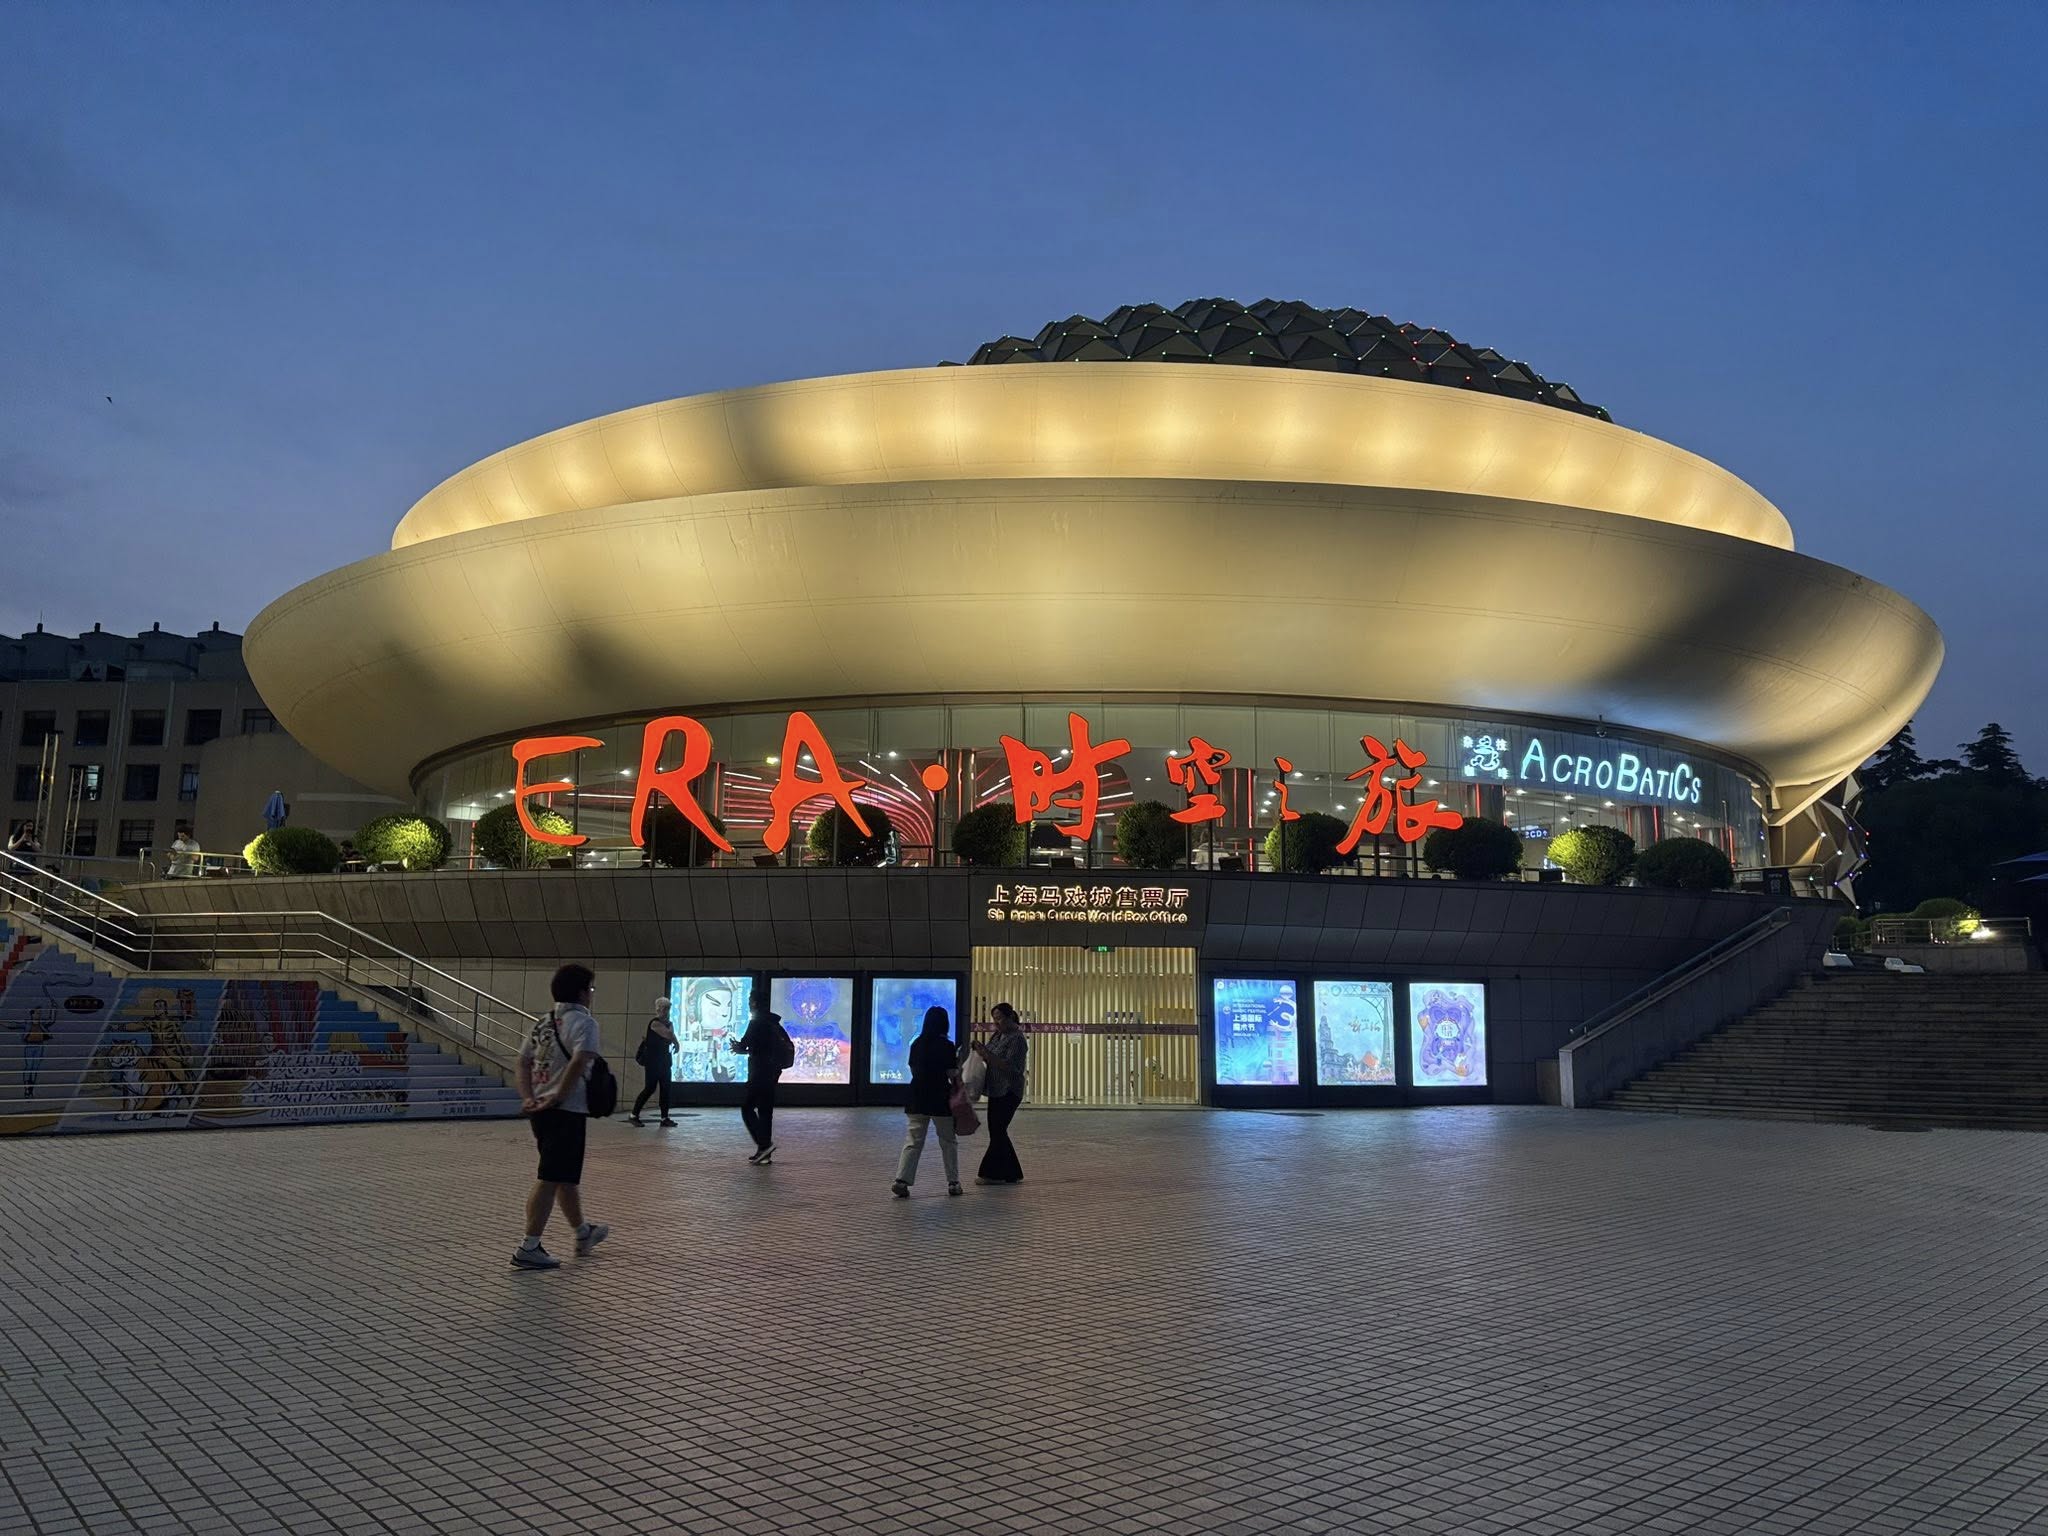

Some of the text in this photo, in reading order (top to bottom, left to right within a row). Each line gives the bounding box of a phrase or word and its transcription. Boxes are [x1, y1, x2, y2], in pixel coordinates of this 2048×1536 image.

[512, 711, 1464, 856] ERA 时空之旅
[988, 885, 1189, 907] 上海马戏城售票厅
[1047, 908, 1086, 922] Circus
[1087, 908, 1123, 922] World
[1125, 909, 1148, 922] Box
[1149, 909, 1188, 923] Office
[242, 1081, 338, 1106] 全城有戏
[270, 1104, 395, 1119] DRAMA IN THE AIR
